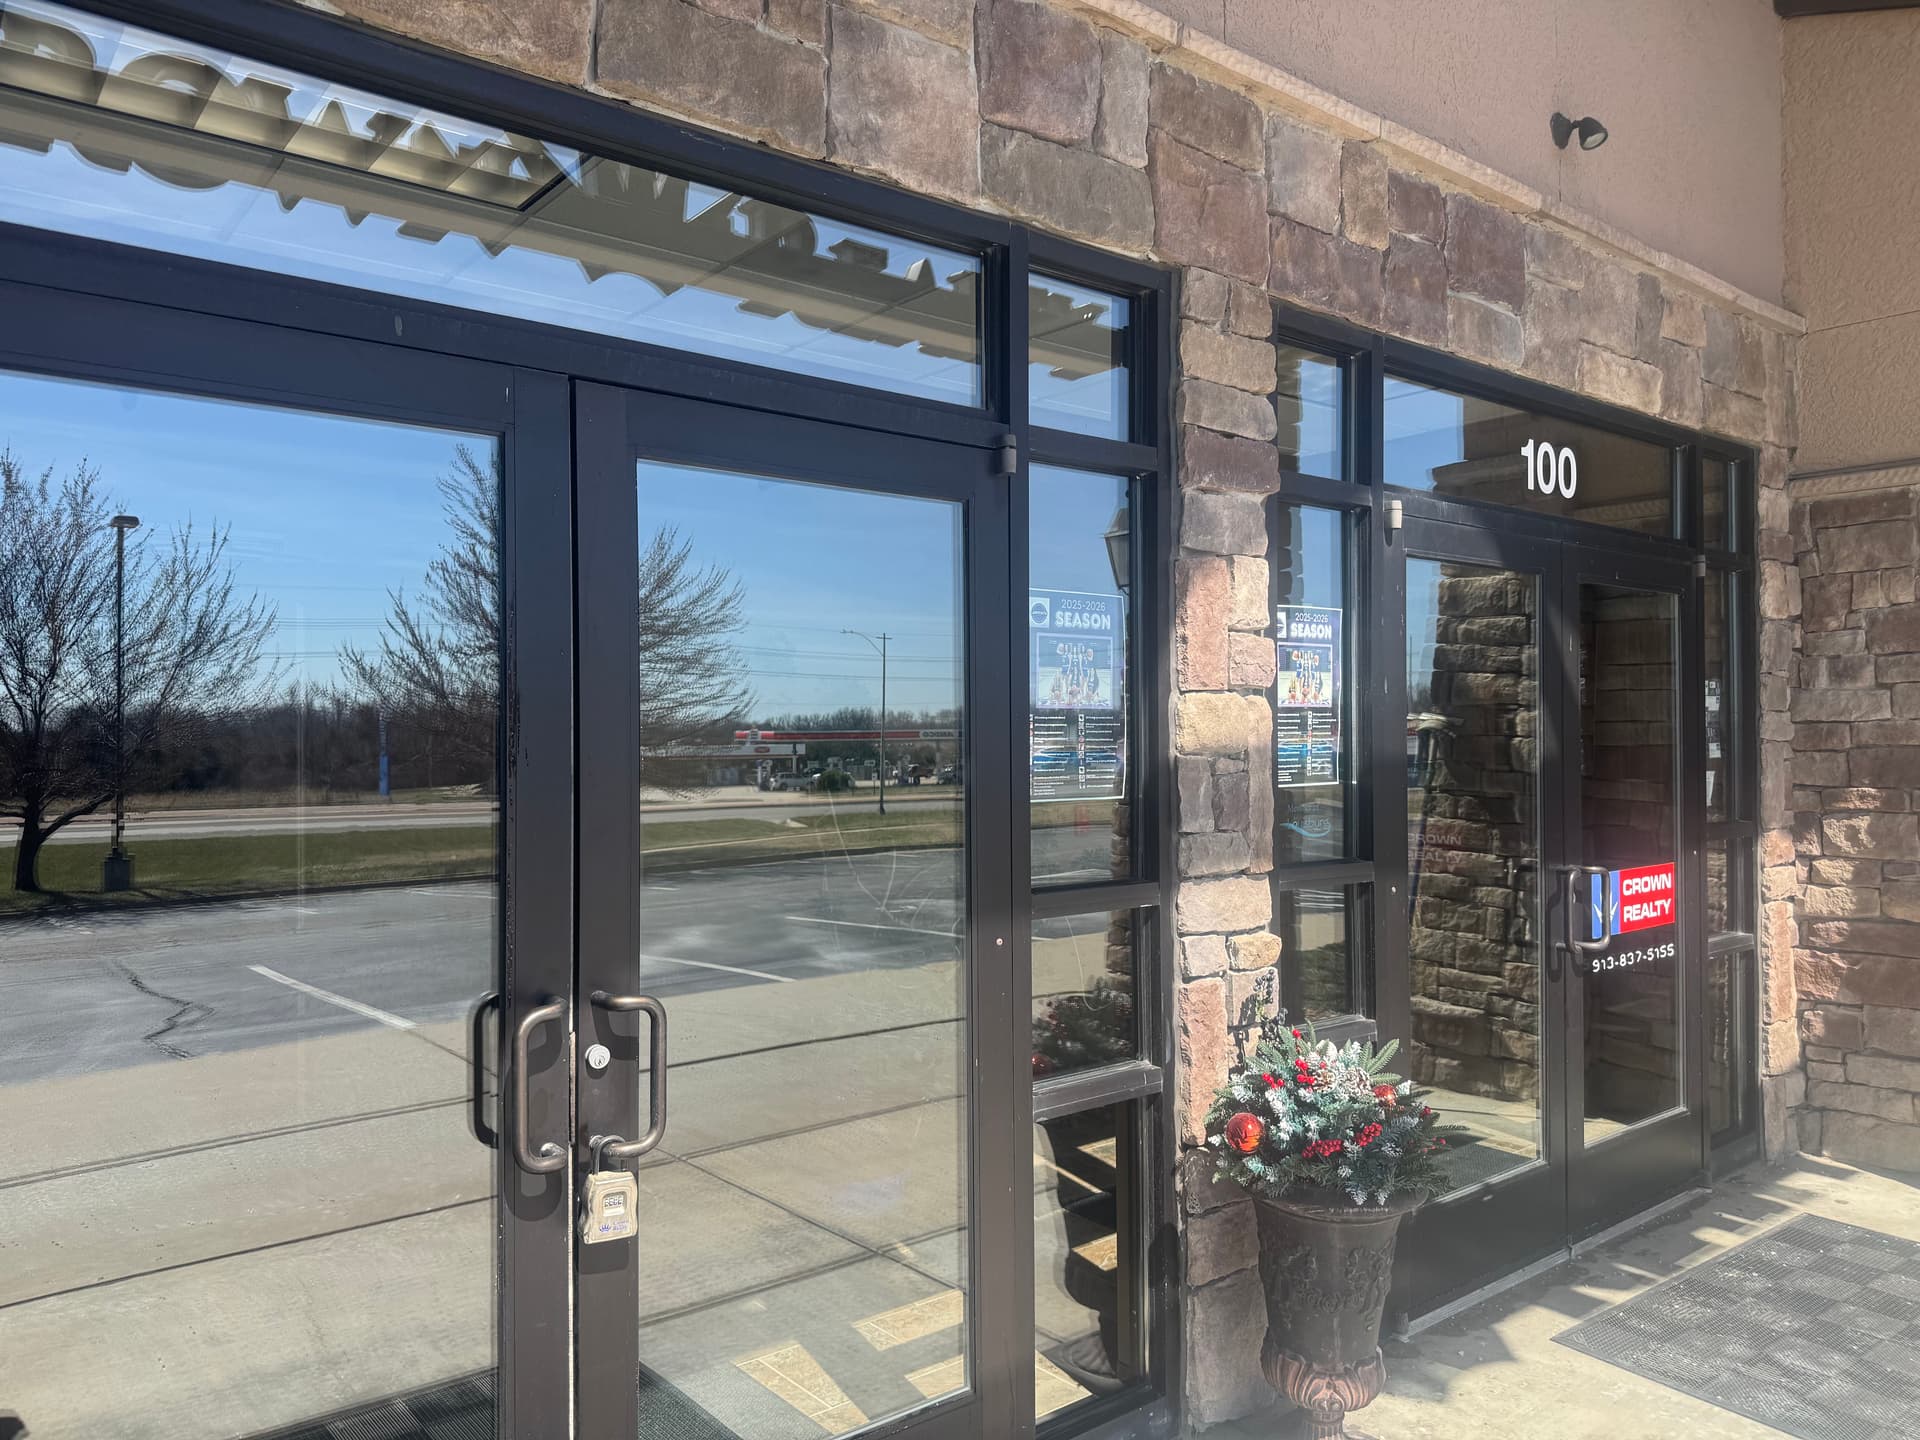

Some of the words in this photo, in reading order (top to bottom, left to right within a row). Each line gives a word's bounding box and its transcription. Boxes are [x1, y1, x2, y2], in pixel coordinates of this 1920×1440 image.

[1521, 438, 1577, 499] 100
[1061, 599, 1106, 612] 2025-2026
[1055, 611, 1111, 630] SEASON
[1295, 612, 1329, 623] 2025-2026
[1290, 622, 1332, 640] SEASON
[1622, 872, 1672, 896] CROWN
[1623, 898, 1671, 923] REALTY
